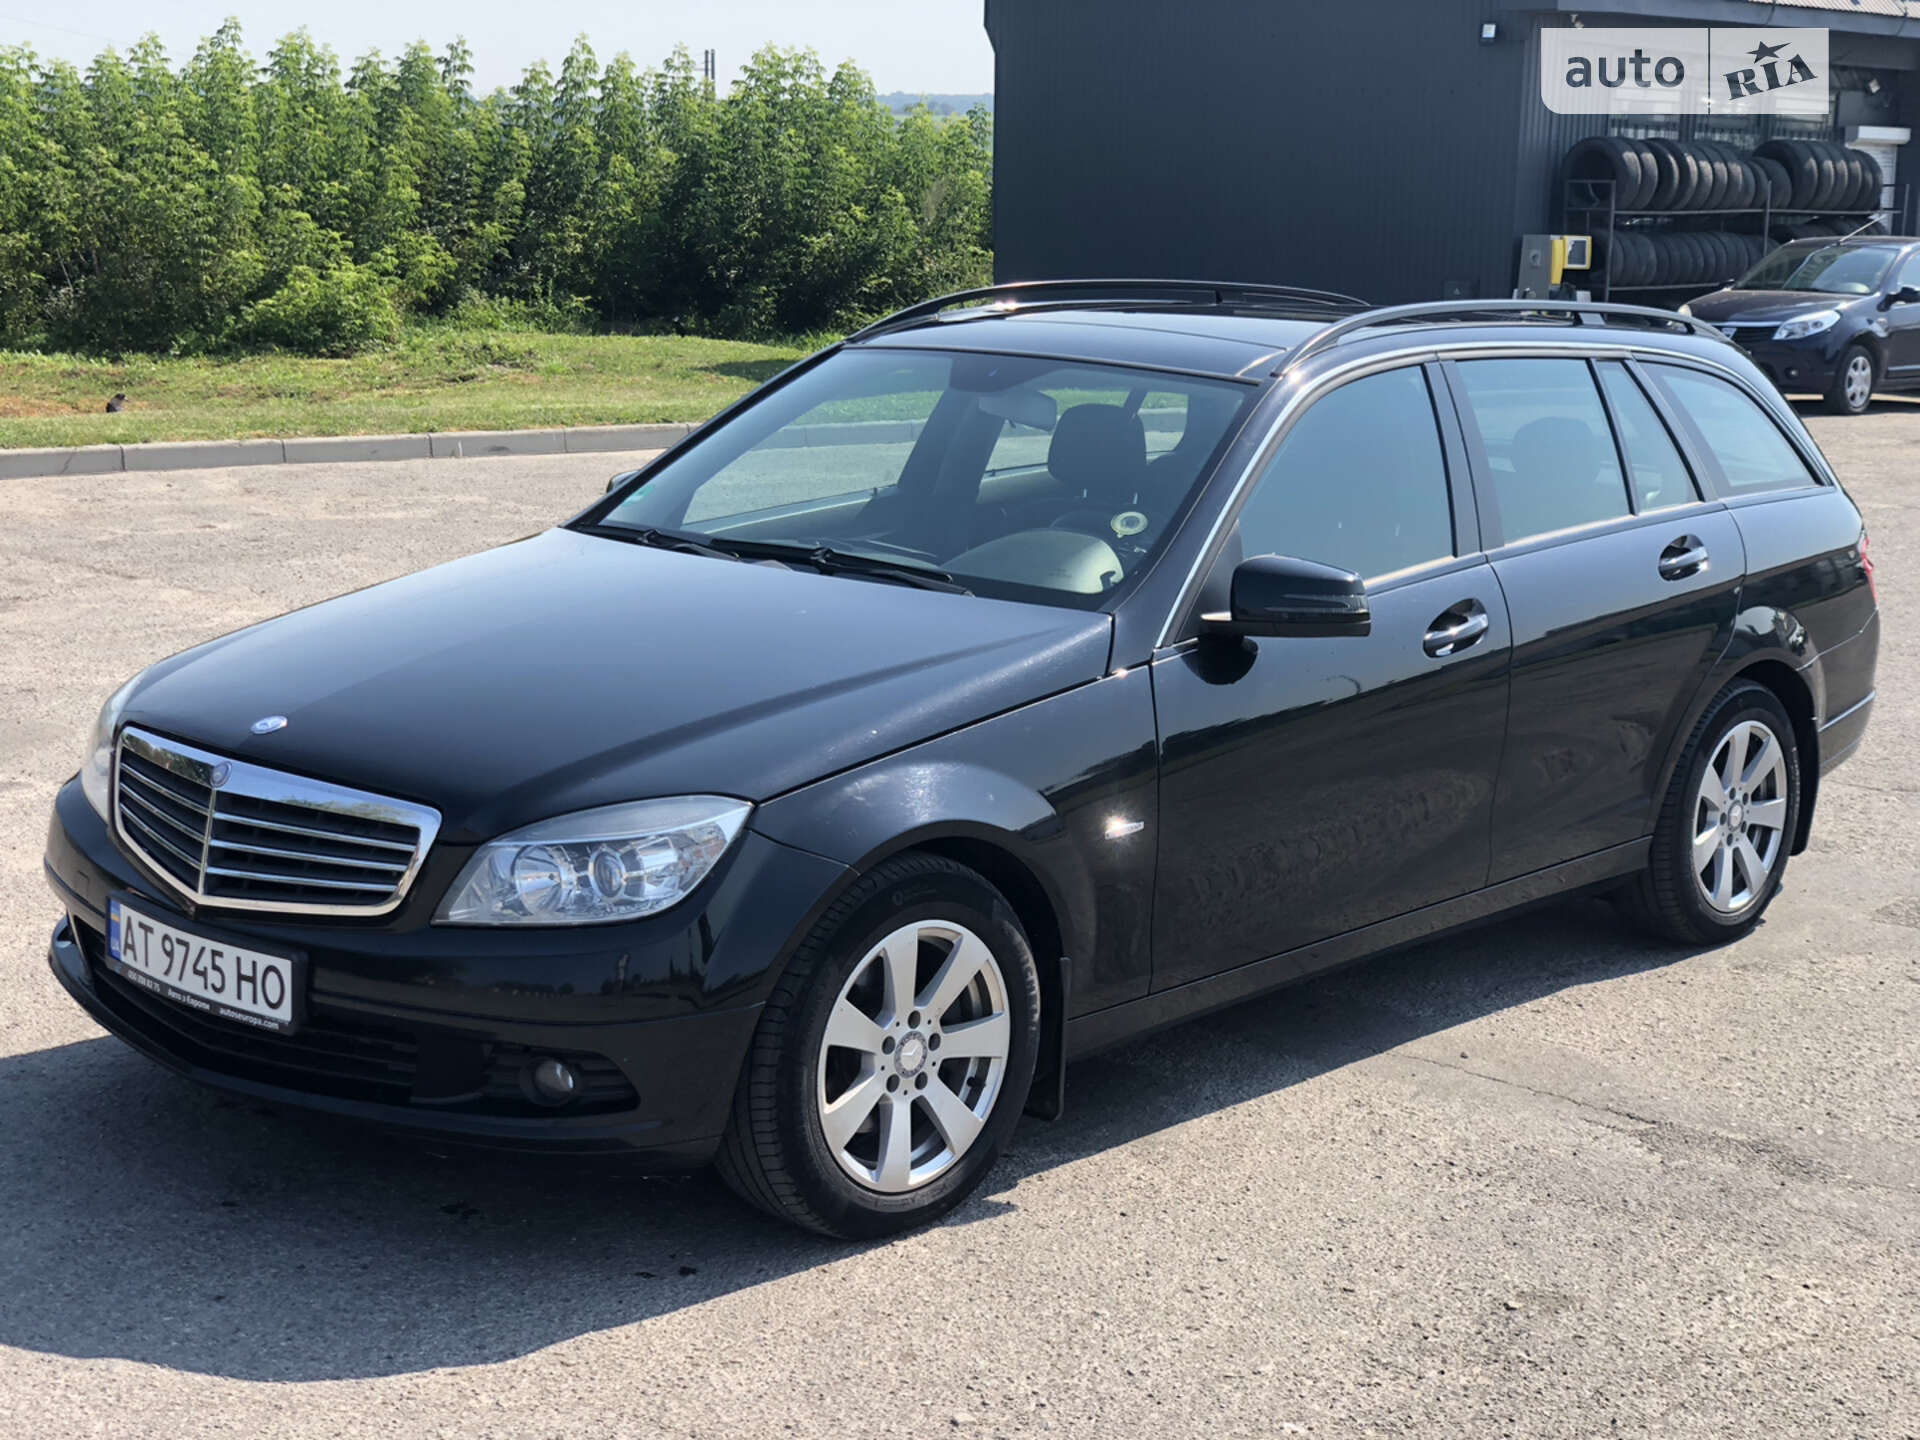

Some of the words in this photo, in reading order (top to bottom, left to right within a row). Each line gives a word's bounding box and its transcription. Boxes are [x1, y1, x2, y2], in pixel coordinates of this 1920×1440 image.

[123, 916, 154, 968] AT
[161, 933, 226, 994] 9745
[236, 956, 286, 1010] HO
